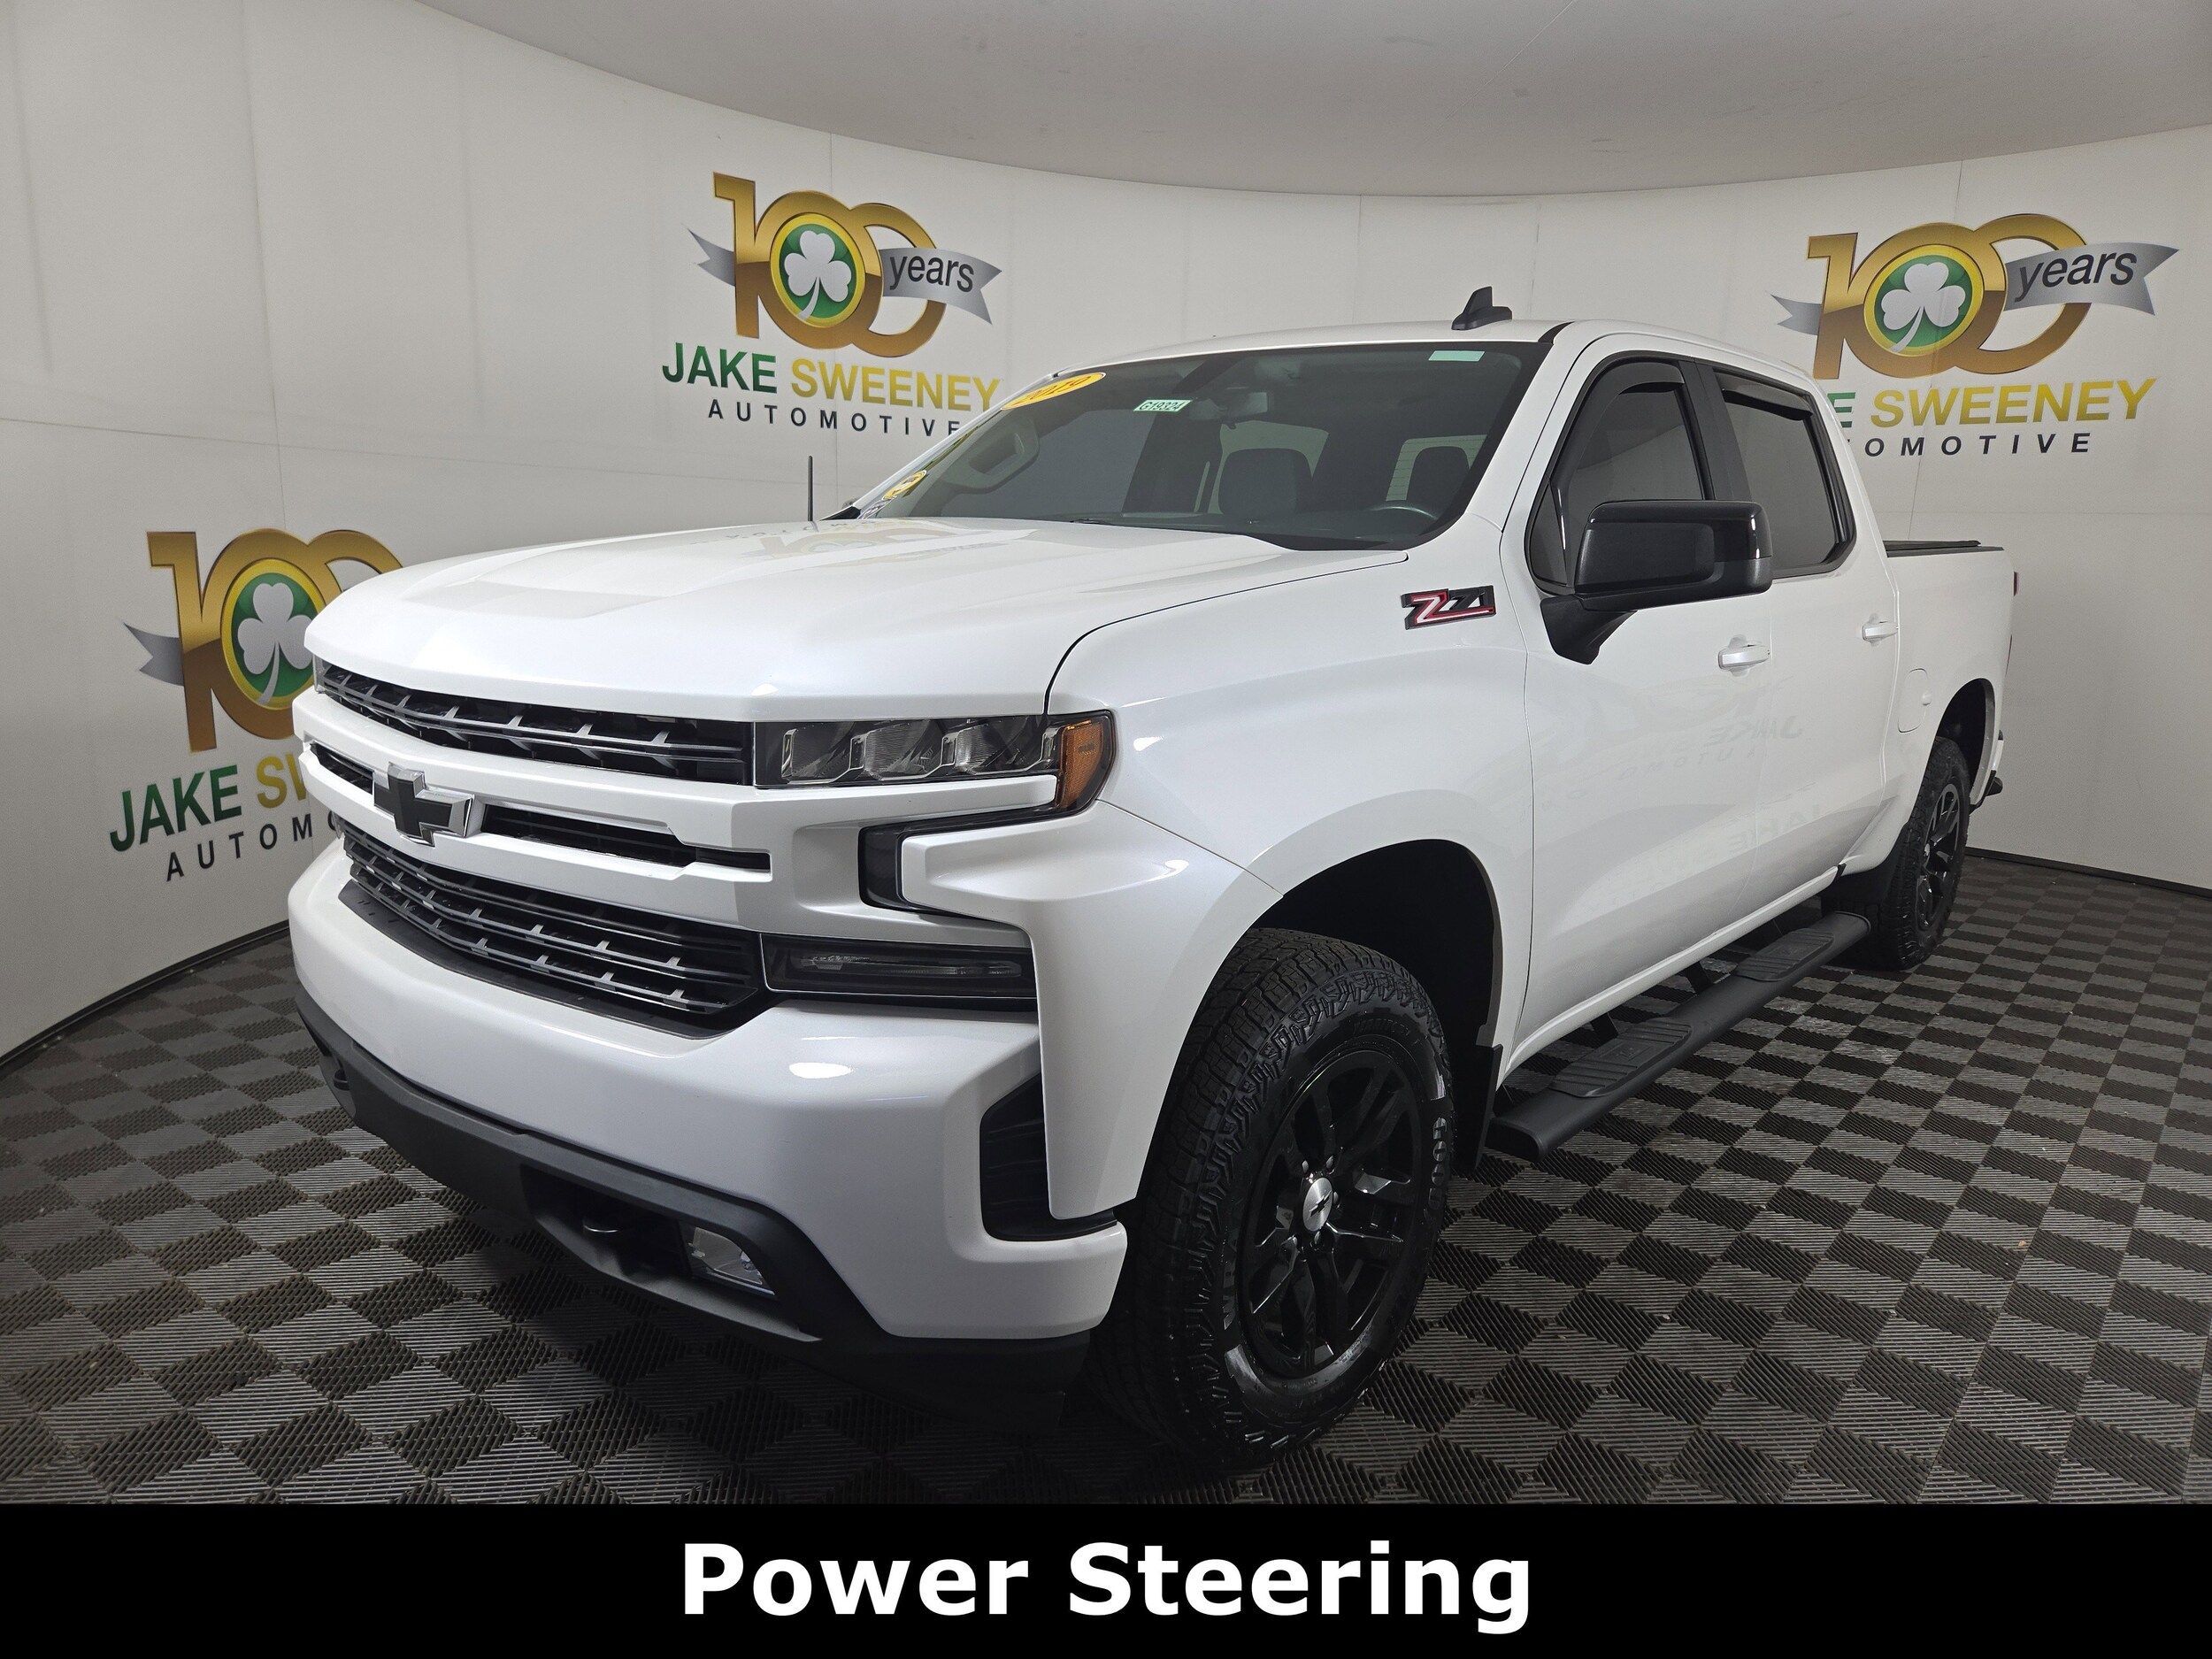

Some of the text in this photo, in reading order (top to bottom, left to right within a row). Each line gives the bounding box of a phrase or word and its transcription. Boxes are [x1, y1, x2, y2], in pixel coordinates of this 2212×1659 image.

[888, 254, 975, 293] years
[2014, 250, 2138, 303] years
[662, 342, 1001, 412] JAKE SWEENEY
[1870, 377, 2157, 428] SWEENEY
[1847, 432, 2090, 457] OMOTIVE
[110, 764, 242, 852] JAKE
